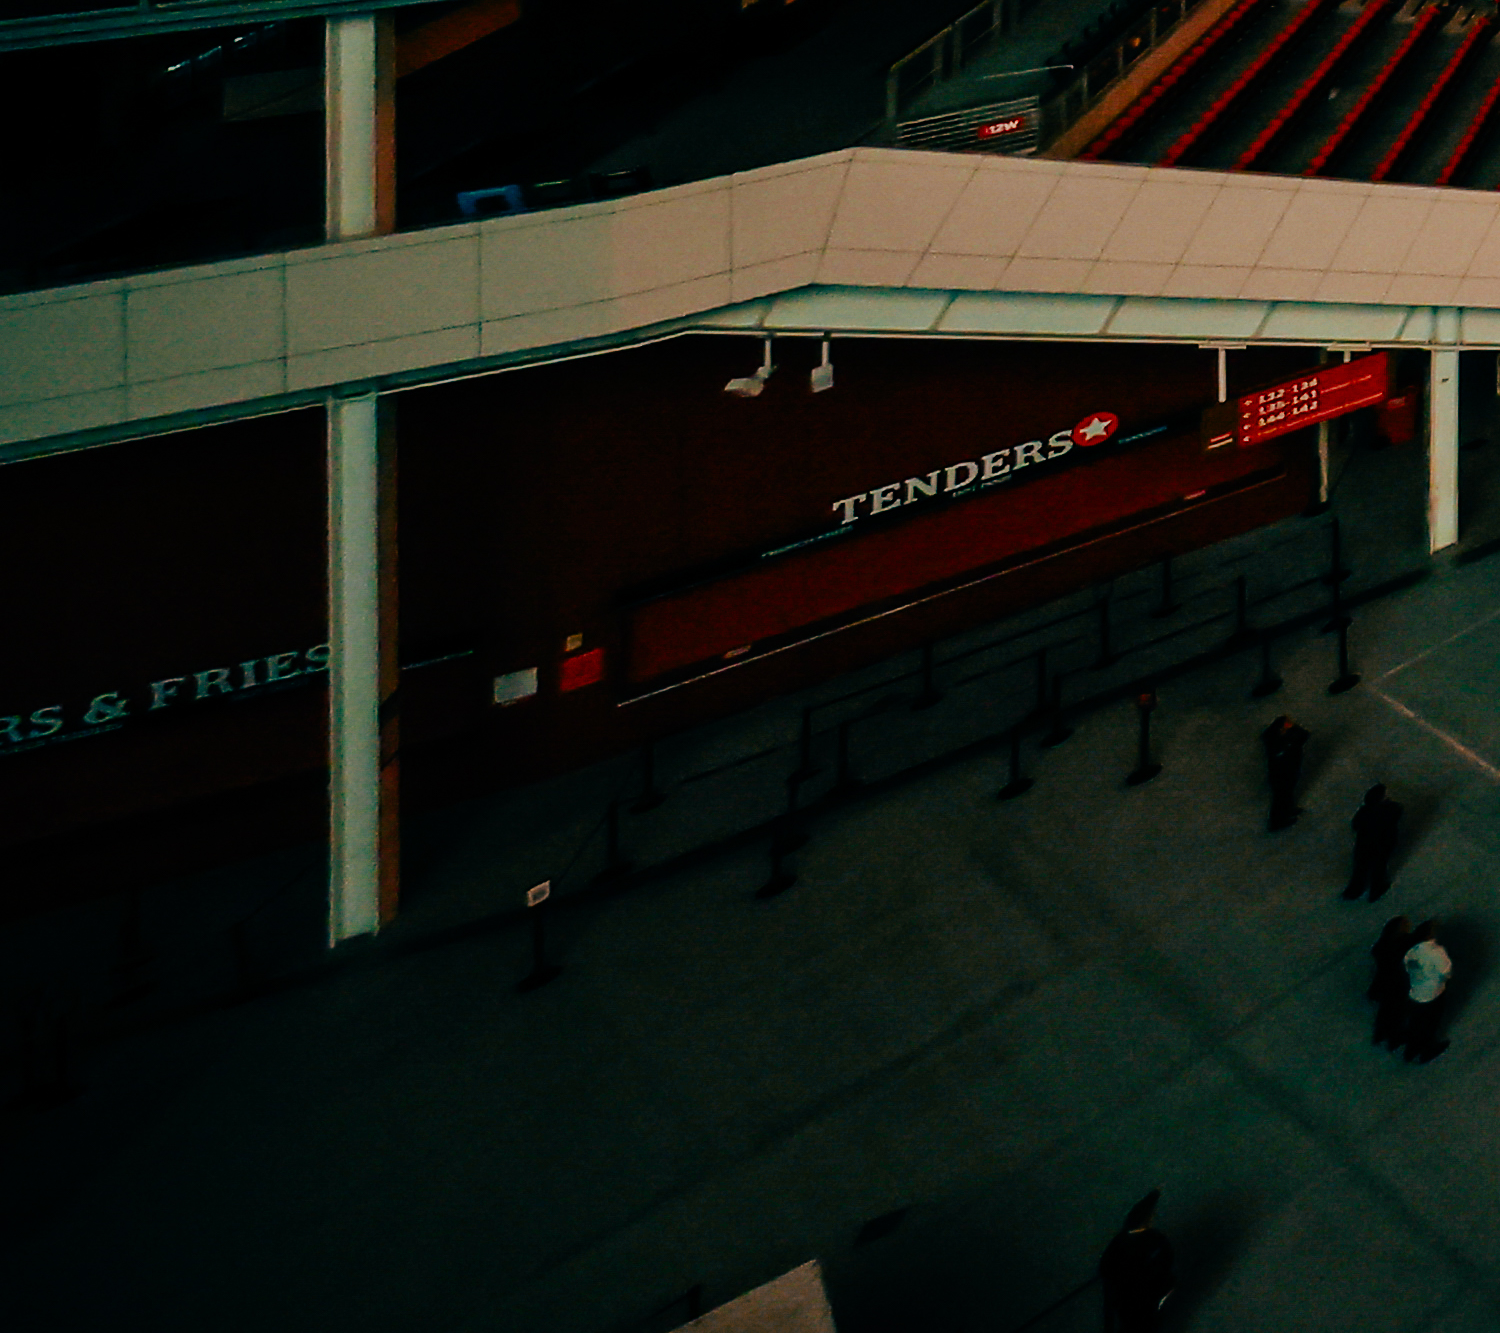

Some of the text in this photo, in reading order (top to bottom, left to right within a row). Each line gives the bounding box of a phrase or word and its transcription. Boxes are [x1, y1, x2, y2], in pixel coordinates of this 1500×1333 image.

[832, 429, 1074, 526] TENDERS
[82, 690, 132, 724] &
[148, 643, 329, 712] FRIES
